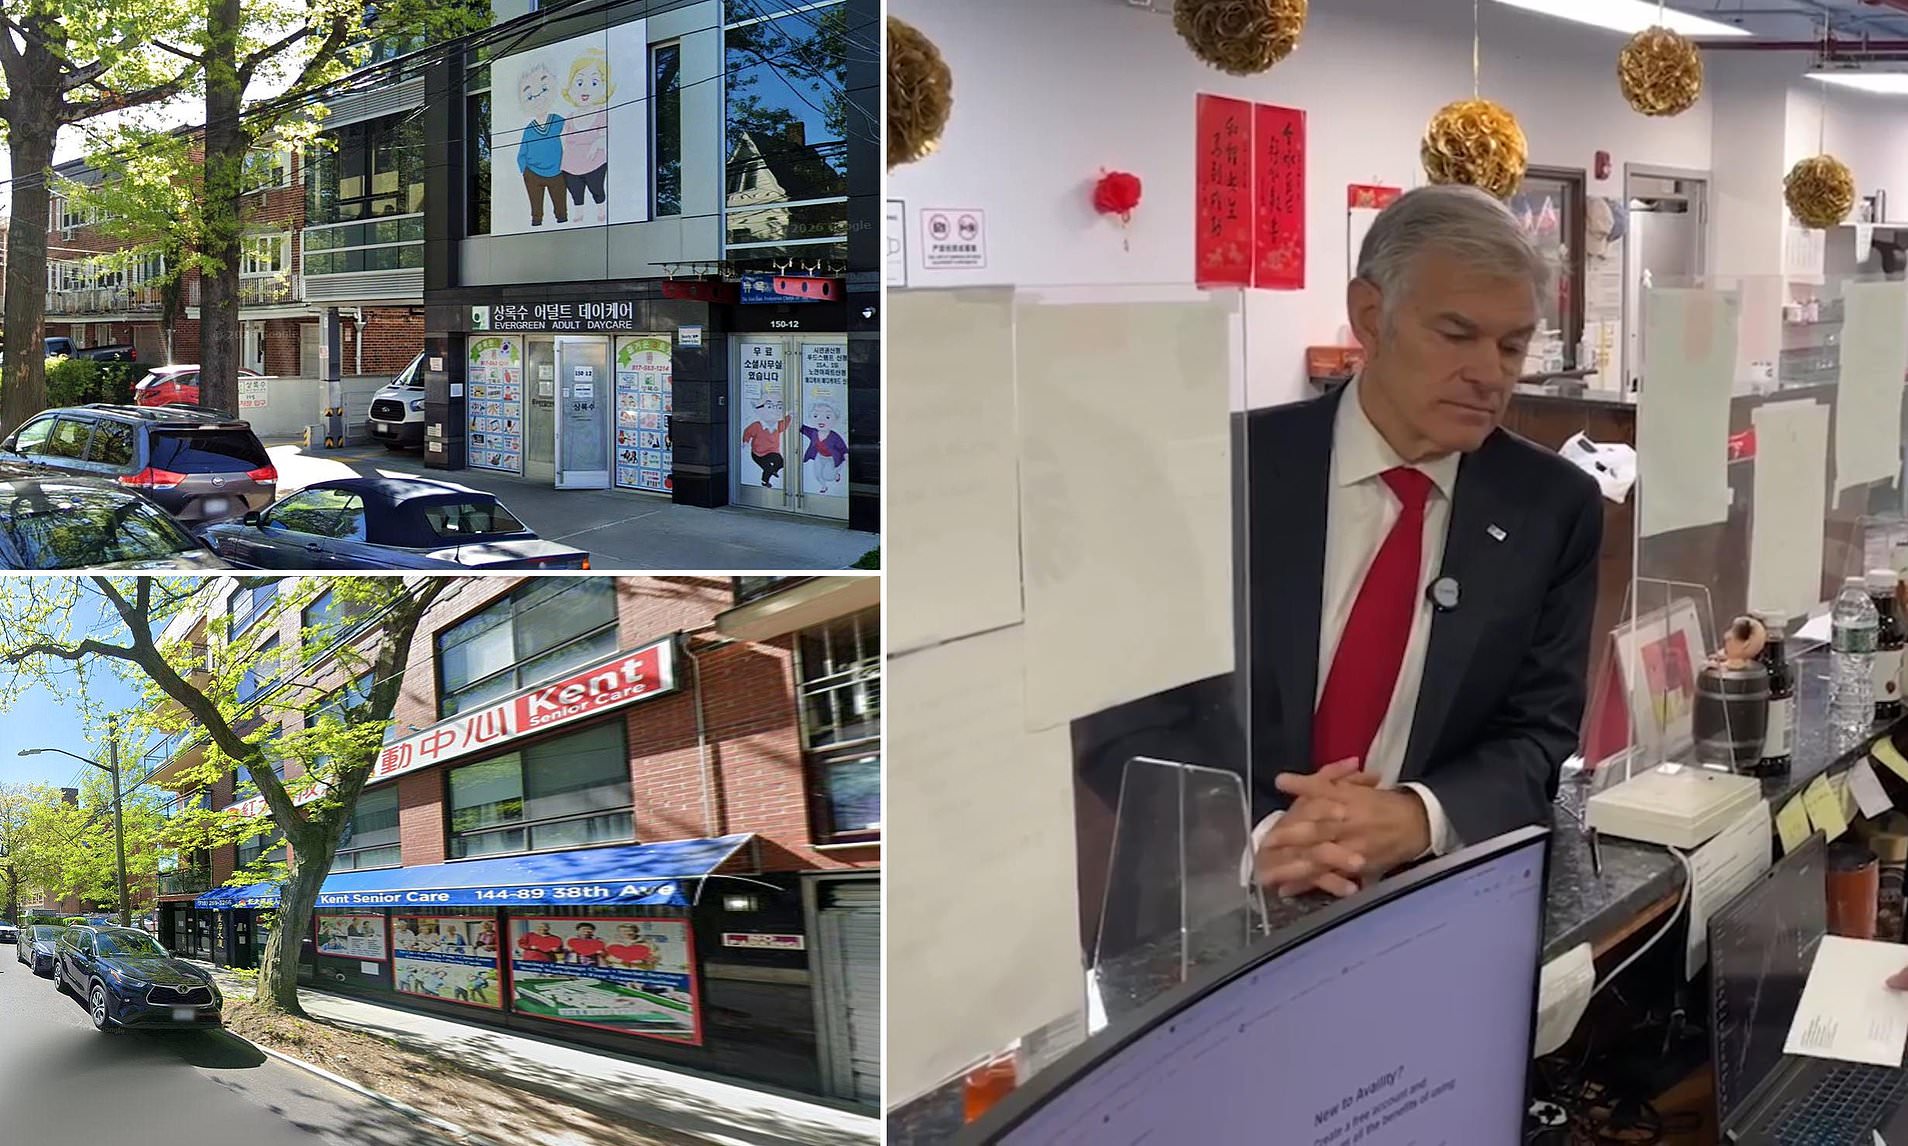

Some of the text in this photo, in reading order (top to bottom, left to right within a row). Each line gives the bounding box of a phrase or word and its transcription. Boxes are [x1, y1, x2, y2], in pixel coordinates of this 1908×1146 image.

[494, 302, 633, 321] 상록수 어덜트 데이케어
[495, 320, 633, 330] EVERGREEN ADULT DAYCARE
[770, 320, 799, 328] 150-12
[527, 658, 646, 717] Kent
[529, 682, 647, 728] Senior Care
[321, 882, 676, 904] Kent Senior Care 144-89 38th Ave
[1314, 1104, 1340, 1127] New
[1341, 1096, 1353, 1111] to
